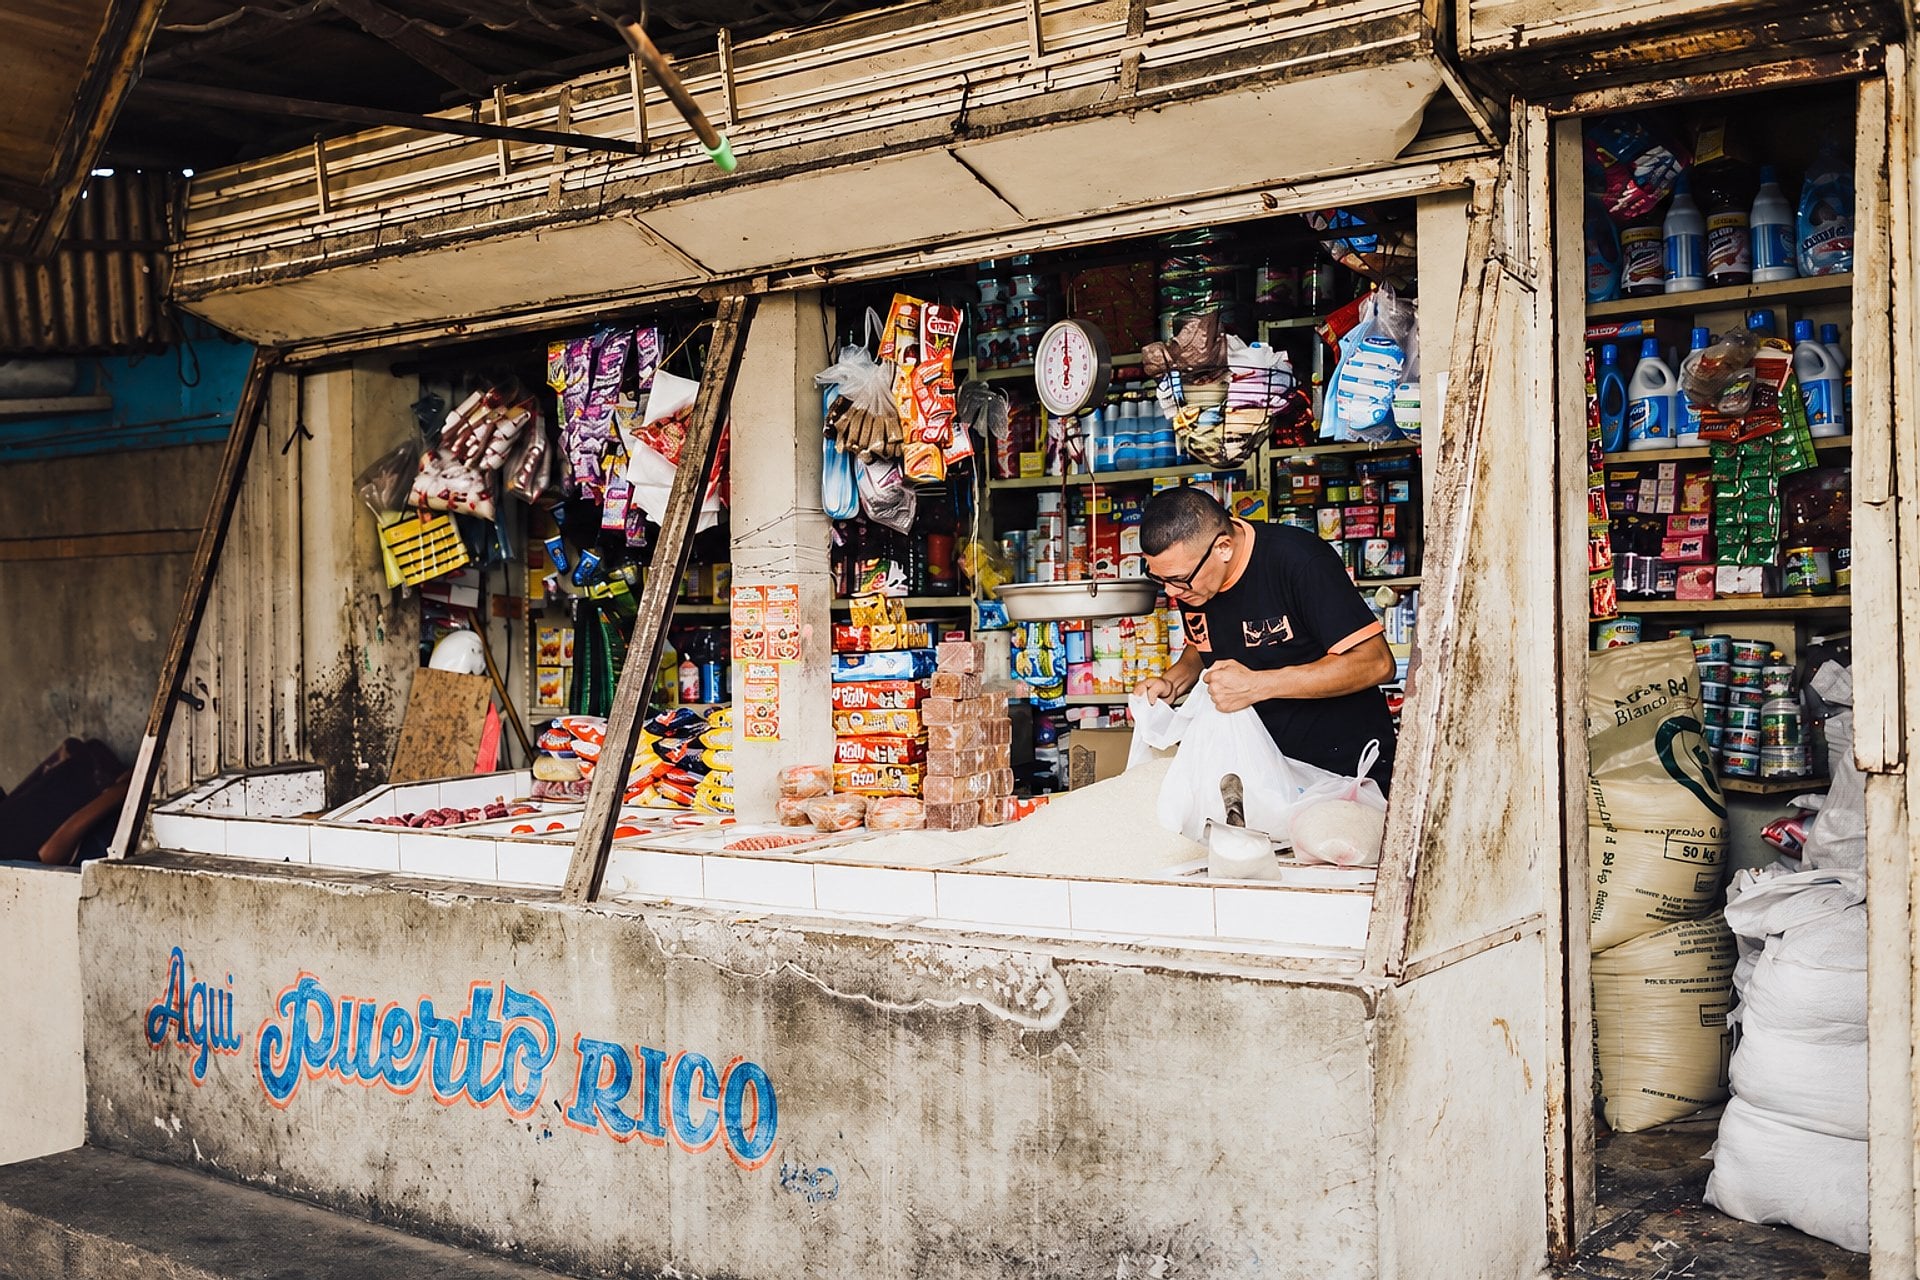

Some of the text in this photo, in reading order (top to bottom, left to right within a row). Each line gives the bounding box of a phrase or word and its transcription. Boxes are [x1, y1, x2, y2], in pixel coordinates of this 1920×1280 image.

[1614, 695, 1667, 727] Blanco
[1682, 845, 1699, 859] 50
[258, 973, 559, 1116] Puerto
[565, 1034, 778, 1168] RICO
